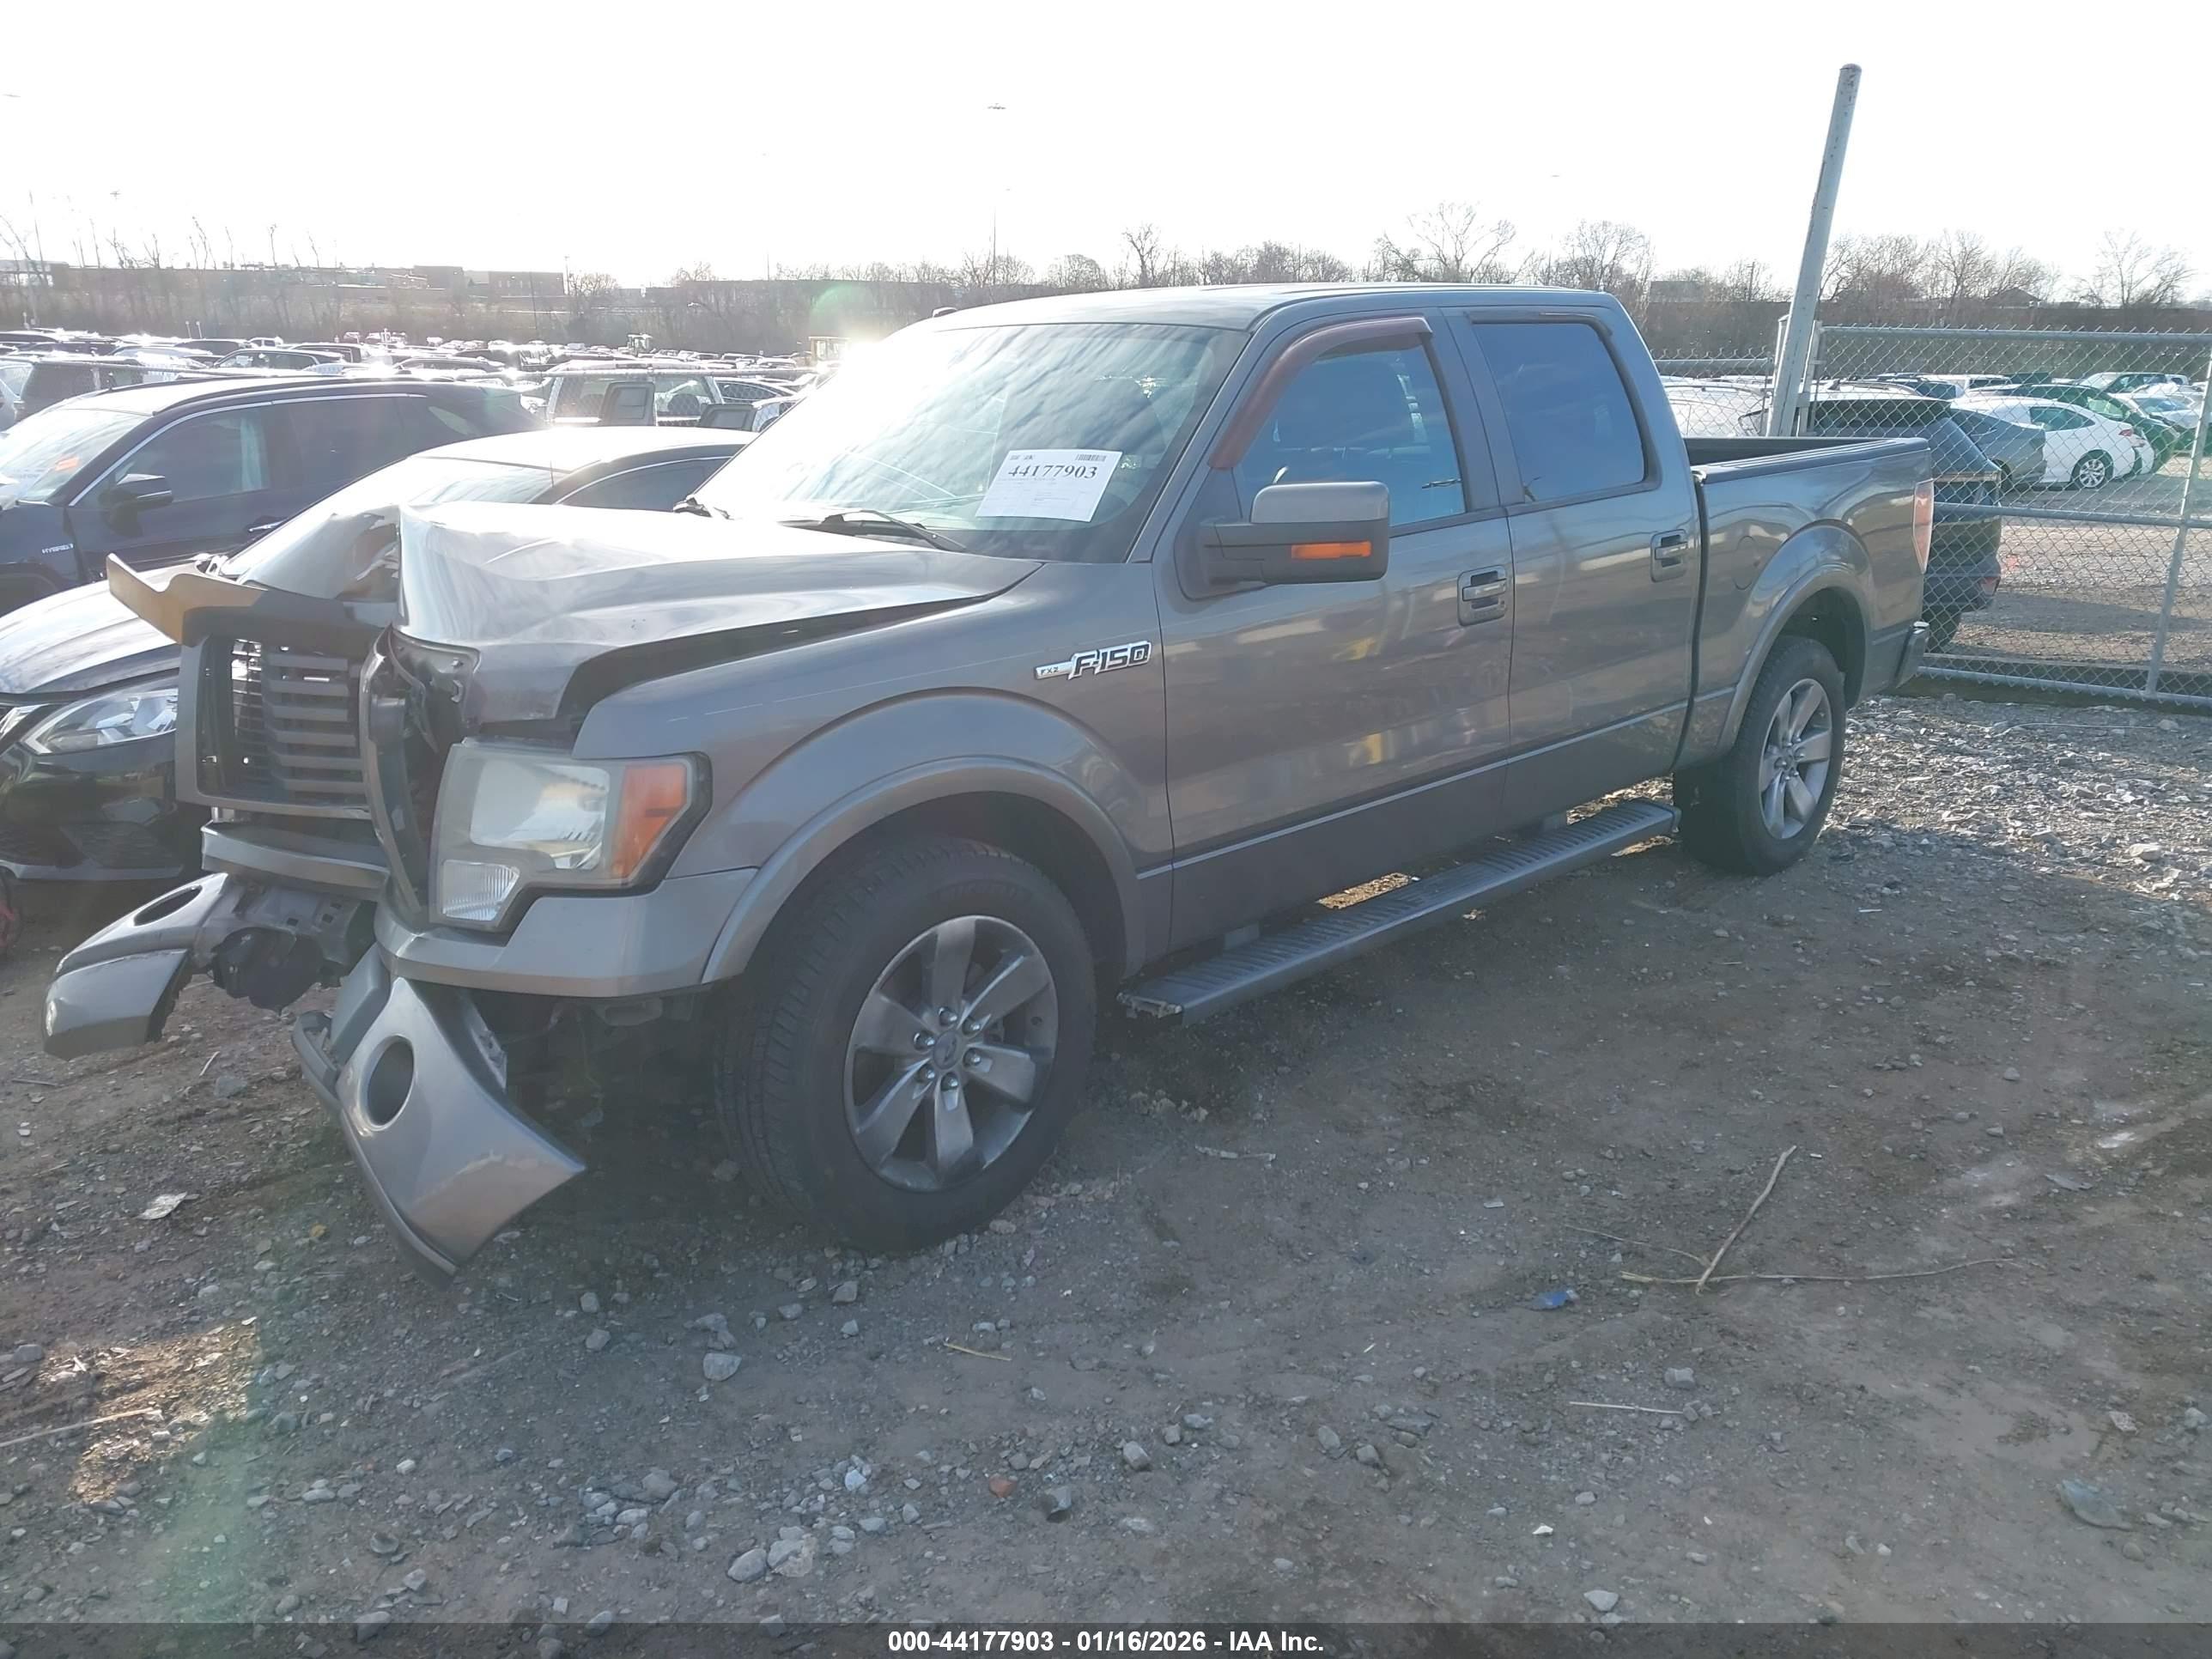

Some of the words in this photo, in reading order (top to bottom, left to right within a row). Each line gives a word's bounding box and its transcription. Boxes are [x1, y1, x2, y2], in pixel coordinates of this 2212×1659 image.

[1008, 465, 1097, 479] 44177903
[1040, 666, 1059, 676] FX2
[1069, 641, 1152, 678] F-150
